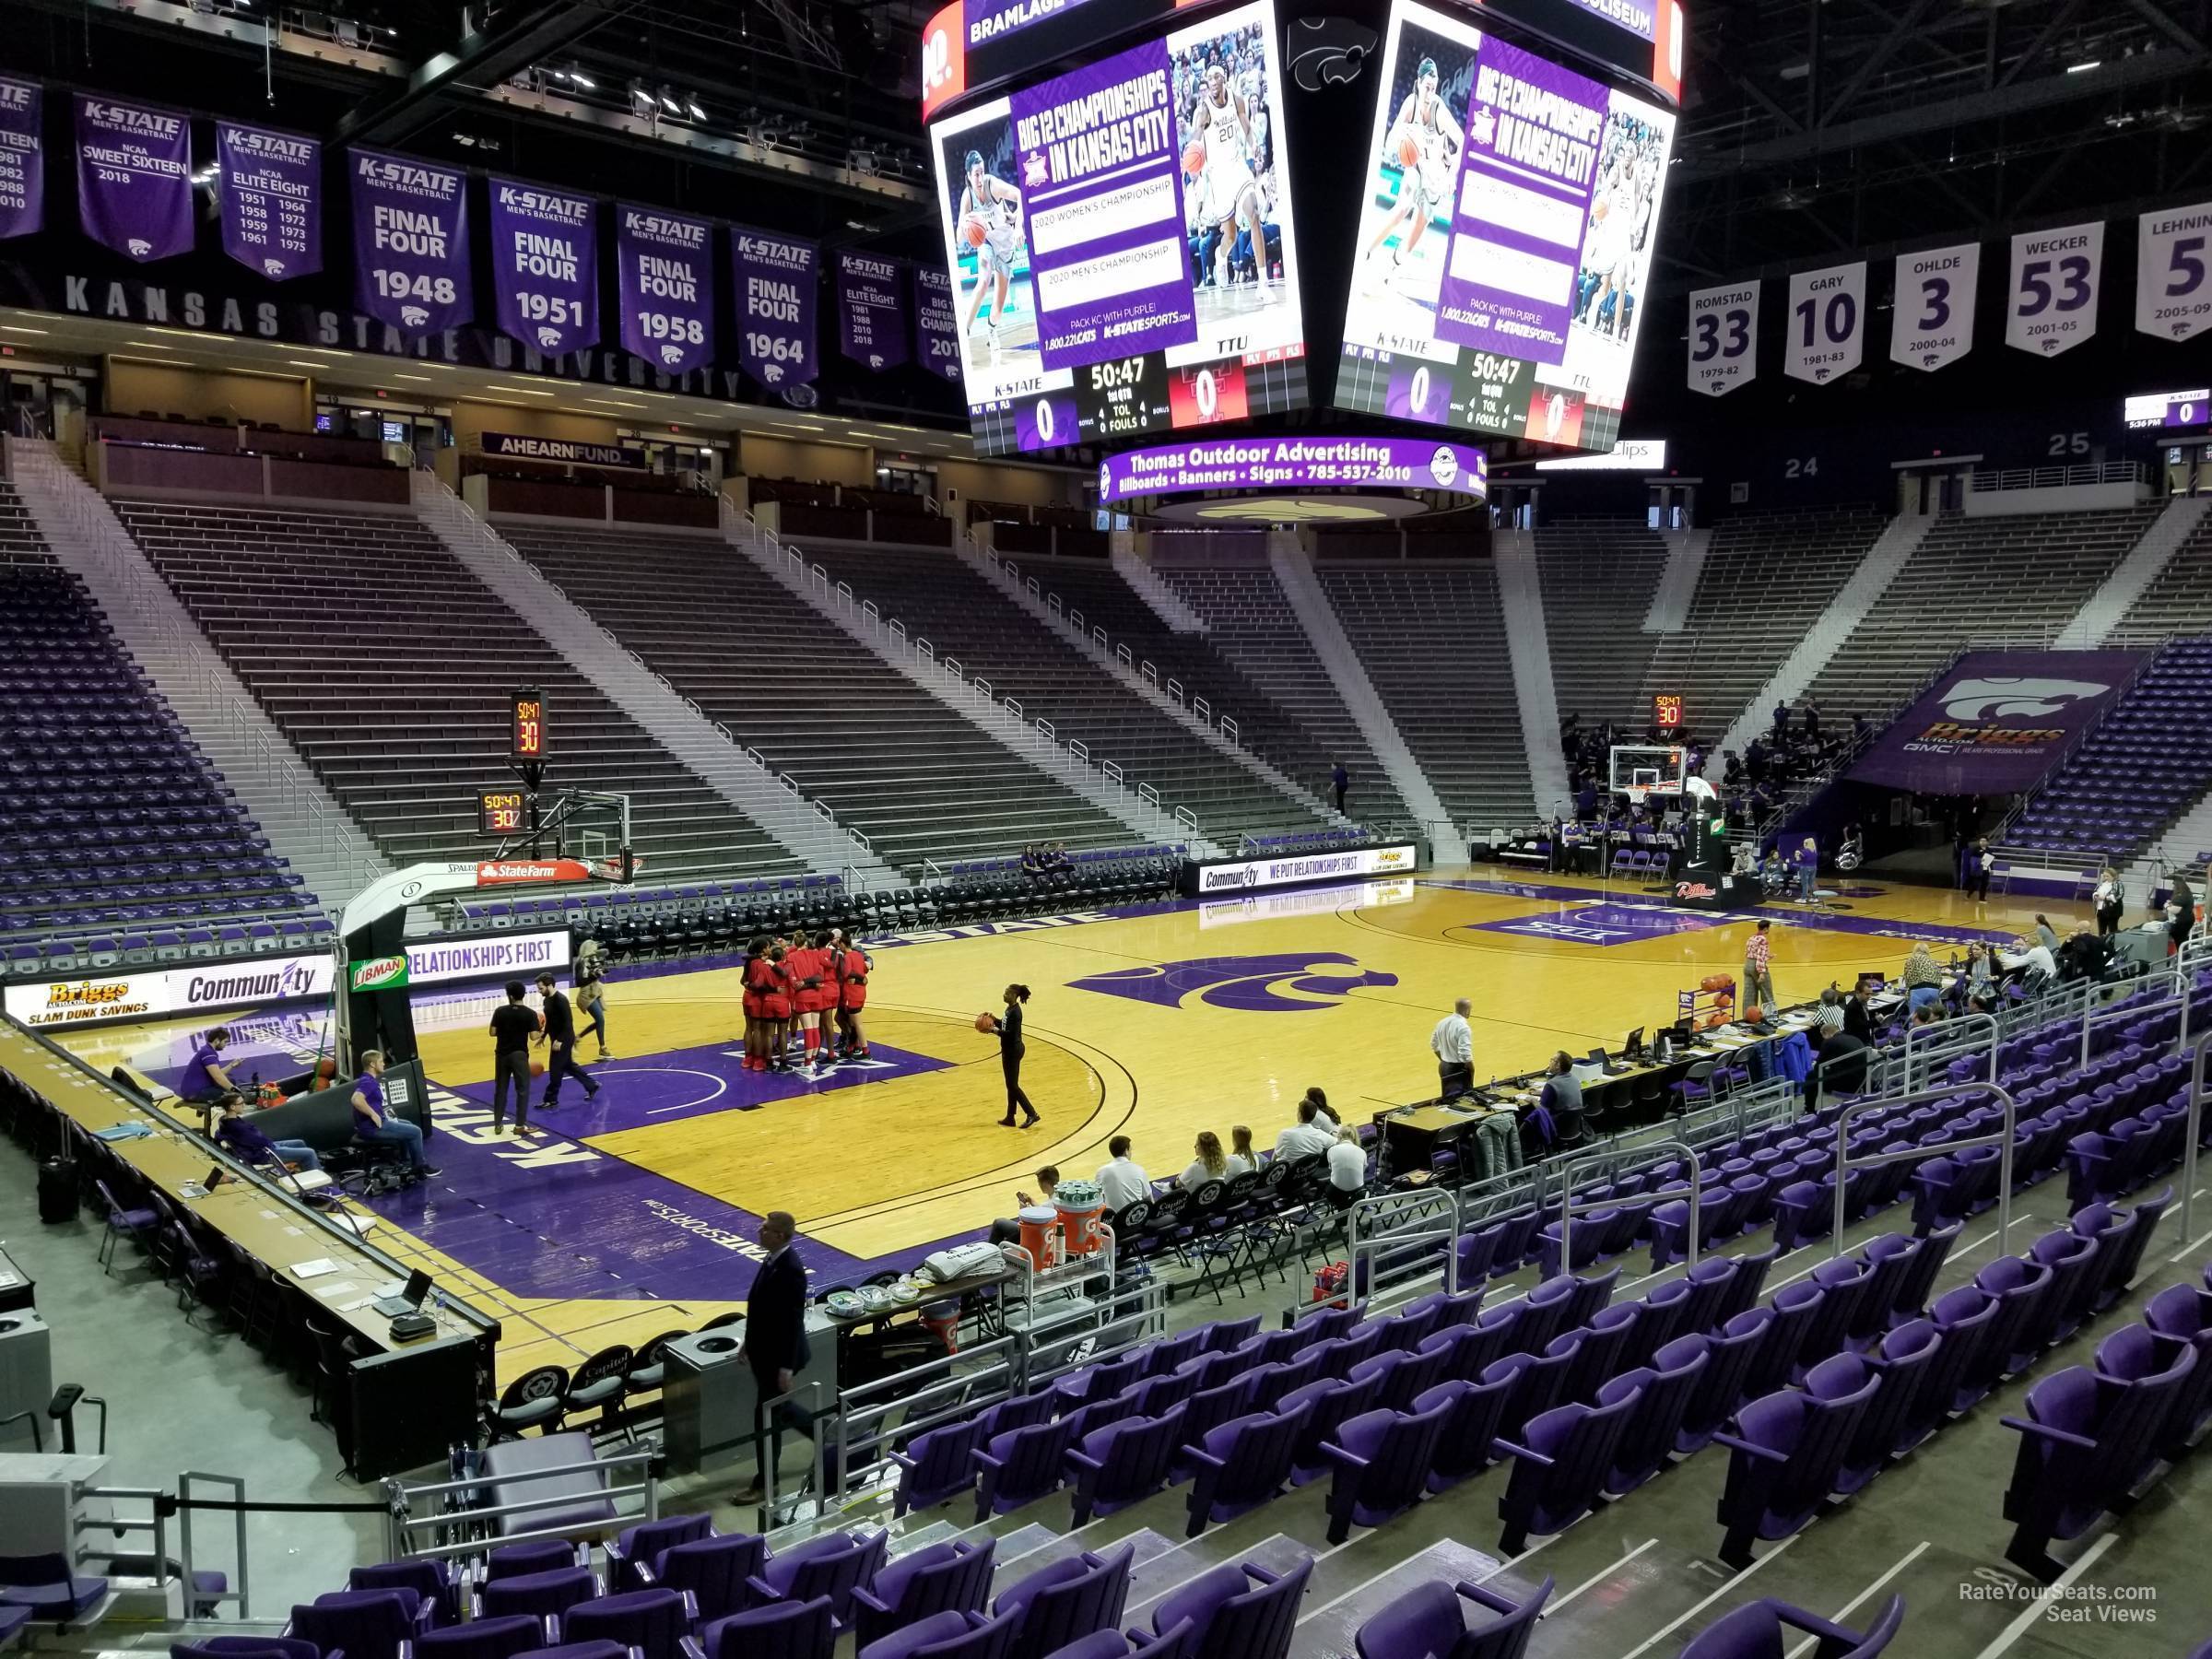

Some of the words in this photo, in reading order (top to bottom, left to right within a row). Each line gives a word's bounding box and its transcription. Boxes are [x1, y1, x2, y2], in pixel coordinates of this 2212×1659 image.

[1017, 114, 1041, 152] BIG
[1040, 109, 1056, 145] 12
[1054, 69, 1168, 138] CHAMPIONSHIPS
[1476, 64, 1500, 105] BIG
[1497, 72, 1514, 112] 12
[1510, 78, 1603, 146] CHAMPIONSHIPS
[85, 101, 181, 134] K-STATE
[92, 119, 120, 131] MEN'S
[122, 125, 175, 141] BASKETBALL
[1219, 125, 1234, 143] 20
[123, 144, 147, 156] NCAA
[227, 129, 313, 159] K-STATE
[233, 145, 257, 156] MEN'S
[259, 150, 307, 166] BASKETBALL
[1048, 142, 1069, 183] IN
[1067, 120, 1134, 178] KANSAS
[1132, 106, 1170, 157] CITY
[1494, 112, 1515, 157] IN
[1511, 118, 1570, 176] KANSAS
[1564, 140, 1597, 185] CITY
[83, 146, 131, 165] SWEET
[132, 155, 187, 175] SIXTEEN
[99, 169, 131, 183] 2018
[232, 171, 268, 189] ELITE
[270, 179, 310, 196] EIGHT
[259, 169, 282, 180] NCAA
[359, 158, 457, 193] K-STATE
[366, 177, 394, 190] MEN'S
[396, 183, 452, 201] BASKETBALL
[239, 192, 265, 205] 1951
[278, 199, 306, 213] 1964
[500, 186, 588, 219] K-STATE
[1034, 215, 1055, 229] 2020
[1057, 201, 1099, 222] WOMEN'S
[1100, 180, 1171, 209] CHAMPIONSHIP
[240, 206, 267, 218] 1958
[279, 213, 306, 226] 1972
[374, 206, 447, 238] FINAL
[507, 205, 532, 217] MEN'S
[534, 208, 582, 227] BASKETBALL
[625, 212, 705, 242] K-STATE
[2152, 214, 2212, 236] LEHNIN
[241, 218, 267, 231] 1959
[280, 226, 306, 239] 1973
[631, 229, 654, 241] MEN'S
[656, 234, 700, 250] BASKETBALL
[241, 231, 267, 244] 1961
[280, 239, 306, 252] 1975
[375, 229, 446, 258] FOUR
[514, 231, 578, 262] FINAL
[738, 236, 812, 265] K-STATE
[2026, 235, 2088, 255] WECKER
[515, 253, 577, 282] FOUR
[639, 254, 697, 284] FINAL
[743, 253, 764, 264] MEN'S
[765, 256, 806, 271] BASKETBALL
[841, 255, 895, 276] K-STATE
[1049, 271, 1070, 285] 2020
[1071, 264, 1098, 277] MEN'S
[1100, 245, 1169, 272] CHAMPIONSHIP
[1913, 256, 1961, 275] OHLDE
[2165, 236, 2206, 297] 5
[372, 269, 456, 304] 1948
[640, 275, 697, 303] FOUR
[747, 277, 801, 304] FINAL
[1809, 275, 1844, 292] GARY
[2017, 255, 2092, 317] 53
[65, 275, 279, 336] KANSAS
[846, 289, 869, 301] ELITE
[870, 294, 895, 306] EIGHT
[932, 298, 947, 310] BIG
[1695, 290, 1753, 311] ROMSTAD
[1918, 277, 1950, 331] 3
[515, 292, 582, 327] 1951
[747, 297, 799, 324] FOUR
[852, 305, 869, 314] 1981
[1070, 320, 1090, 330] PACK
[1091, 314, 1102, 324] KC
[1102, 311, 1123, 323] WITH
[1124, 302, 1157, 317] PURPLE!
[1470, 298, 1488, 312] PACK
[1488, 302, 1500, 314] KC
[1499, 306, 1516, 318] WITH
[1515, 310, 1543, 325] PURPLE!
[1796, 292, 1856, 348] 10
[2154, 302, 2212, 319] 2005-09
[638, 312, 704, 345] 1958
[853, 324, 872, 335] 2010
[1692, 309, 1750, 362] 33
[2027, 321, 2077, 335] 2001-05
[746, 333, 804, 364] 1964
[853, 335, 873, 345] 2018
[1217, 335, 1248, 355] TTU
[1909, 336, 1956, 352] 2000-04
[1471, 353, 1521, 384] 50:47
[1803, 351, 1845, 366] 1981-83
[1091, 357, 1145, 391] 50:47
[1700, 365, 1739, 379] 1979-82
[994, 377, 1042, 397] K-STATE
[1196, 369, 1217, 417] 0
[1410, 366, 1430, 414] 0
[1112, 405, 1131, 416] TOL
[1482, 399, 1497, 413] TOL
[1547, 394, 1564, 439] 0
[2180, 403, 2193, 423] 0
[1036, 398, 1053, 441] 0
[1109, 417, 1137, 432] FOULS
[1476, 413, 1500, 427] FOULS
[2147, 418, 2161, 427] PM
[2048, 432, 2090, 455] 25
[1130, 453, 1185, 473] Thomas
[1189, 444, 1270, 466] Outdoor
[1275, 441, 1391, 466] Advertising
[1785, 456, 1818, 478] 24
[1119, 474, 1169, 493] Billboards
[1178, 470, 1236, 486] Banners
[1249, 465, 1292, 484] Signs
[1307, 465, 1411, 480] 785-537-2010
[518, 702, 540, 719] 50:47
[1656, 696, 1680, 706] 50:47
[1659, 706, 1677, 724] 30
[521, 722, 539, 752] 30
[1923, 722, 2066, 746] Briggs
[1902, 743, 1954, 754] GMC
[484, 794, 521, 808] 50:47
[494, 810, 513, 828] 30
[1270, 864, 1280, 879] WE
[1280, 863, 1293, 877] PUT
[1294, 857, 1341, 876] RELATIONSHIPS
[1341, 856, 1358, 871] FIRST
[407, 944, 512, 976] RELATIONSHIPS
[515, 939, 552, 963] FIRST
[354, 958, 401, 987] LIBMAN
[50, 982, 129, 1004] Briggs
[29, 1011, 64, 1025] SLAM
[66, 1007, 98, 1020] DUNK
[100, 1002, 149, 1017] SAVINGS
